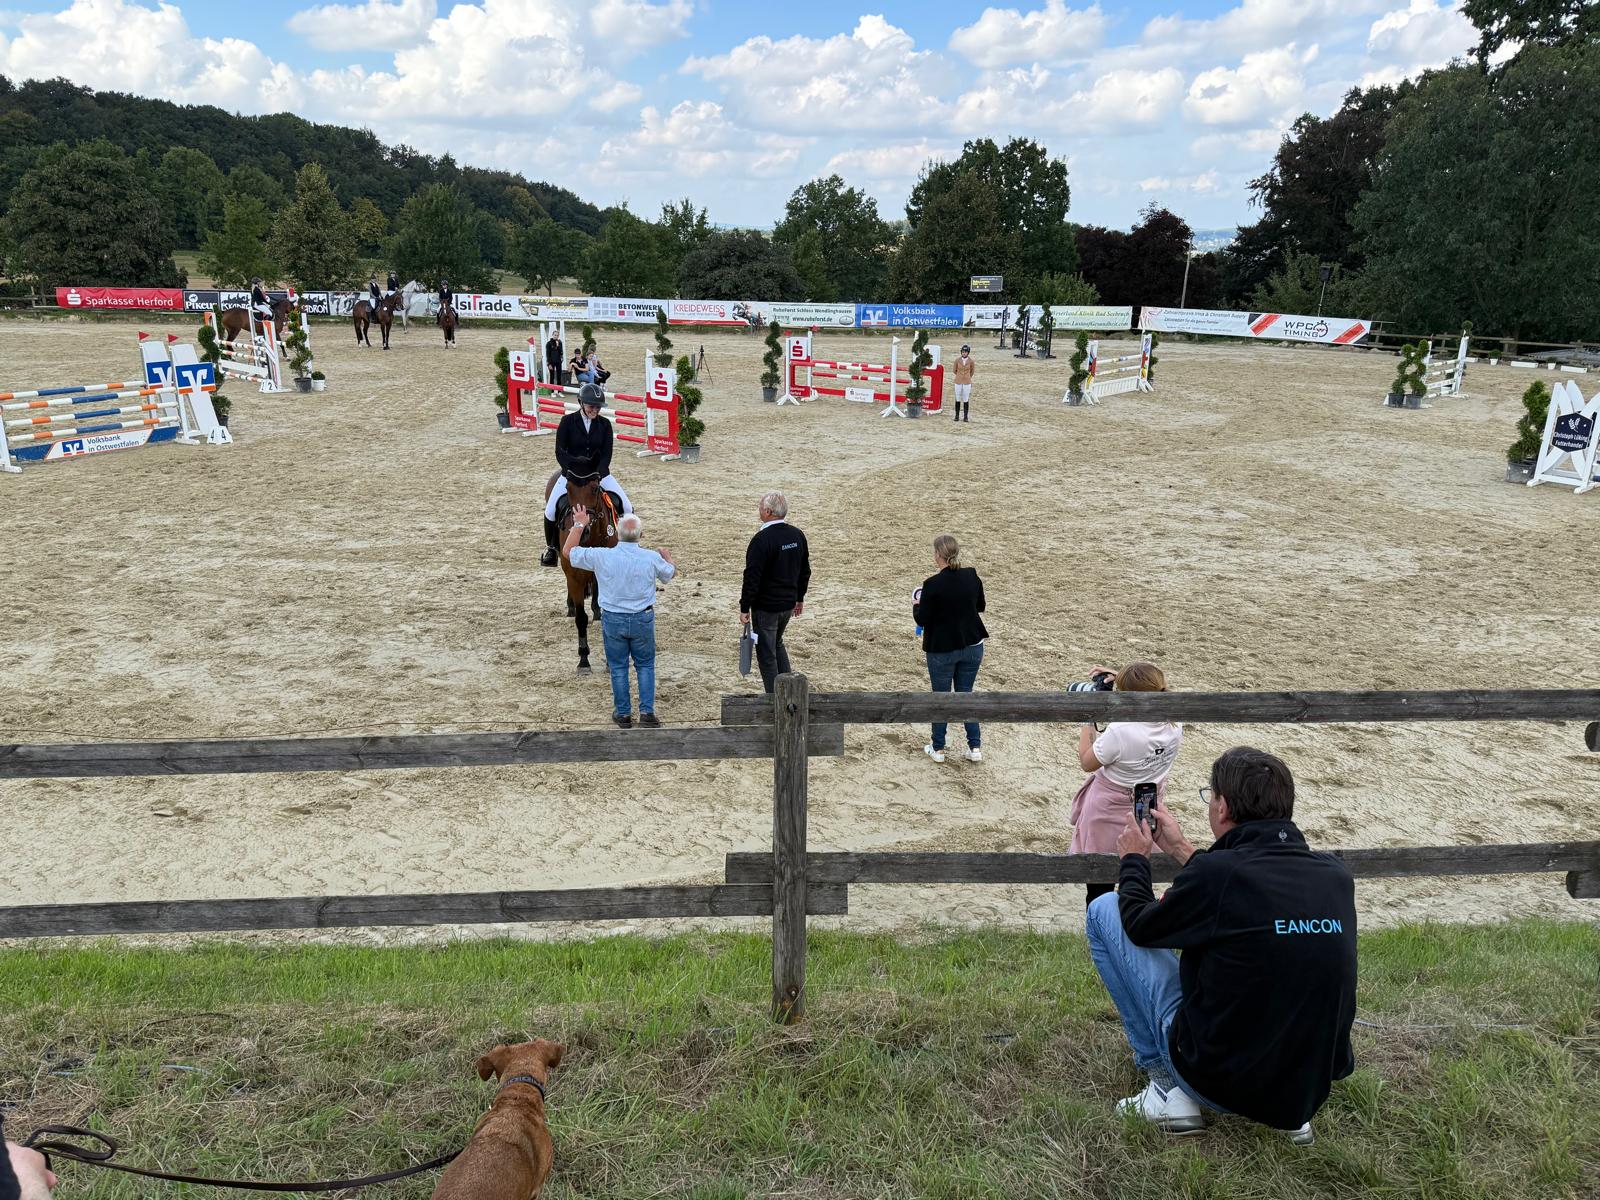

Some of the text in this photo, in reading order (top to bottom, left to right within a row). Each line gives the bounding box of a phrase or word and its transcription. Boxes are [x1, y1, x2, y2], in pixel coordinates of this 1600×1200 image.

[85, 296, 174, 307] Sparkasse Herford
[618, 303, 662, 312] BETONWERK
[673, 303, 725, 313] KREIDEWEISS
[892, 306, 937, 315] Volksbank
[892, 316, 959, 327] in Ostwestfalen
[1284, 330, 1320, 338] TIMING
[268, 381, 273, 391] 2
[86, 434, 121, 445] Volksbank
[221, 430, 227, 441] 4
[96, 440, 140, 451] Ostwestfalen
[1555, 440, 1583, 448] Futterhandel
[781, 542, 797, 550] EANCON
[1274, 919, 1343, 935] EANCON
